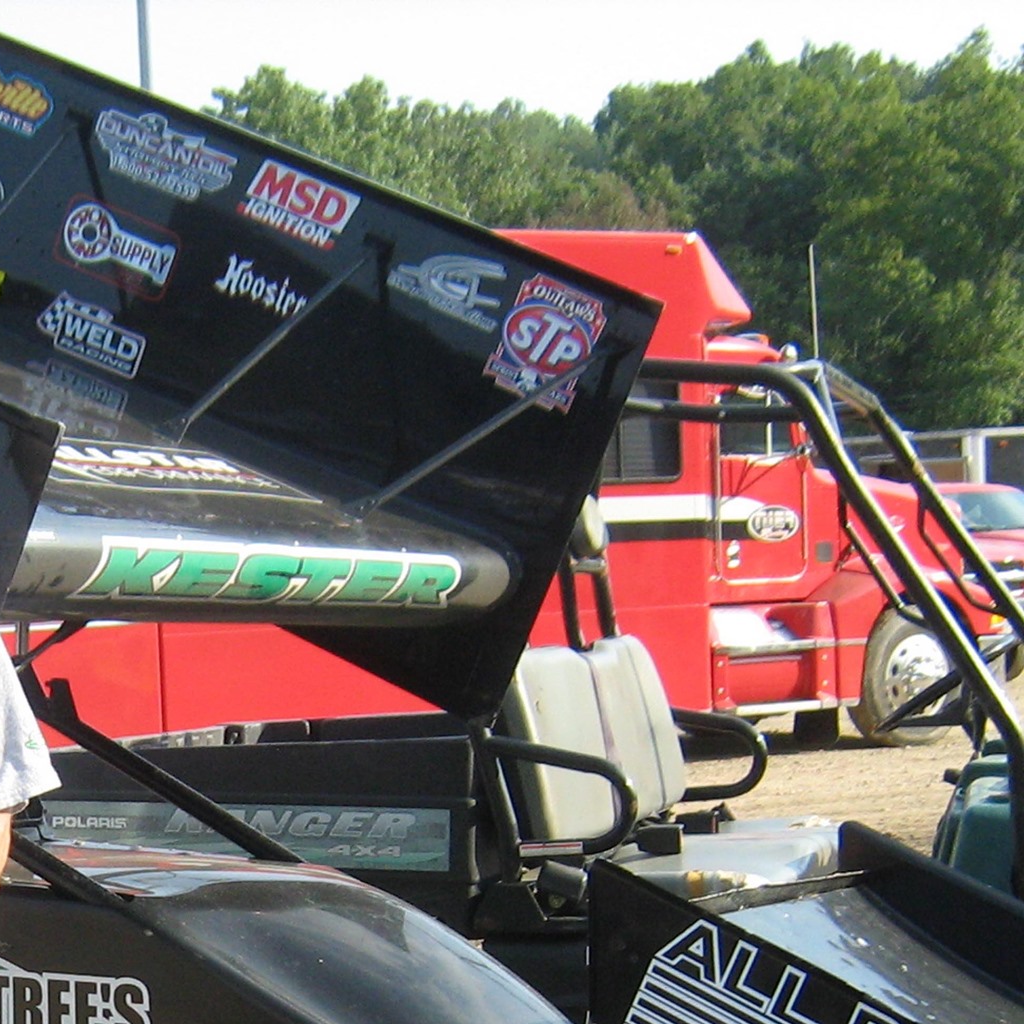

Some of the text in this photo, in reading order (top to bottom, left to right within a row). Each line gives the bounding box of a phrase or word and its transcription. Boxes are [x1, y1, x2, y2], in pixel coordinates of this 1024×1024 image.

[100, 116, 193, 166] DUNCAN
[251, 163, 348, 226] MSD
[243, 198, 331, 248] IGNITION
[110, 235, 171, 275] SUPPLY
[215, 253, 308, 317] Hoosier
[59, 337, 133, 371] RACING
[63, 312, 139, 361] WELD
[511, 312, 583, 366] STP
[72, 541, 461, 607] KESTER
[52, 815, 127, 830] POLARIS
